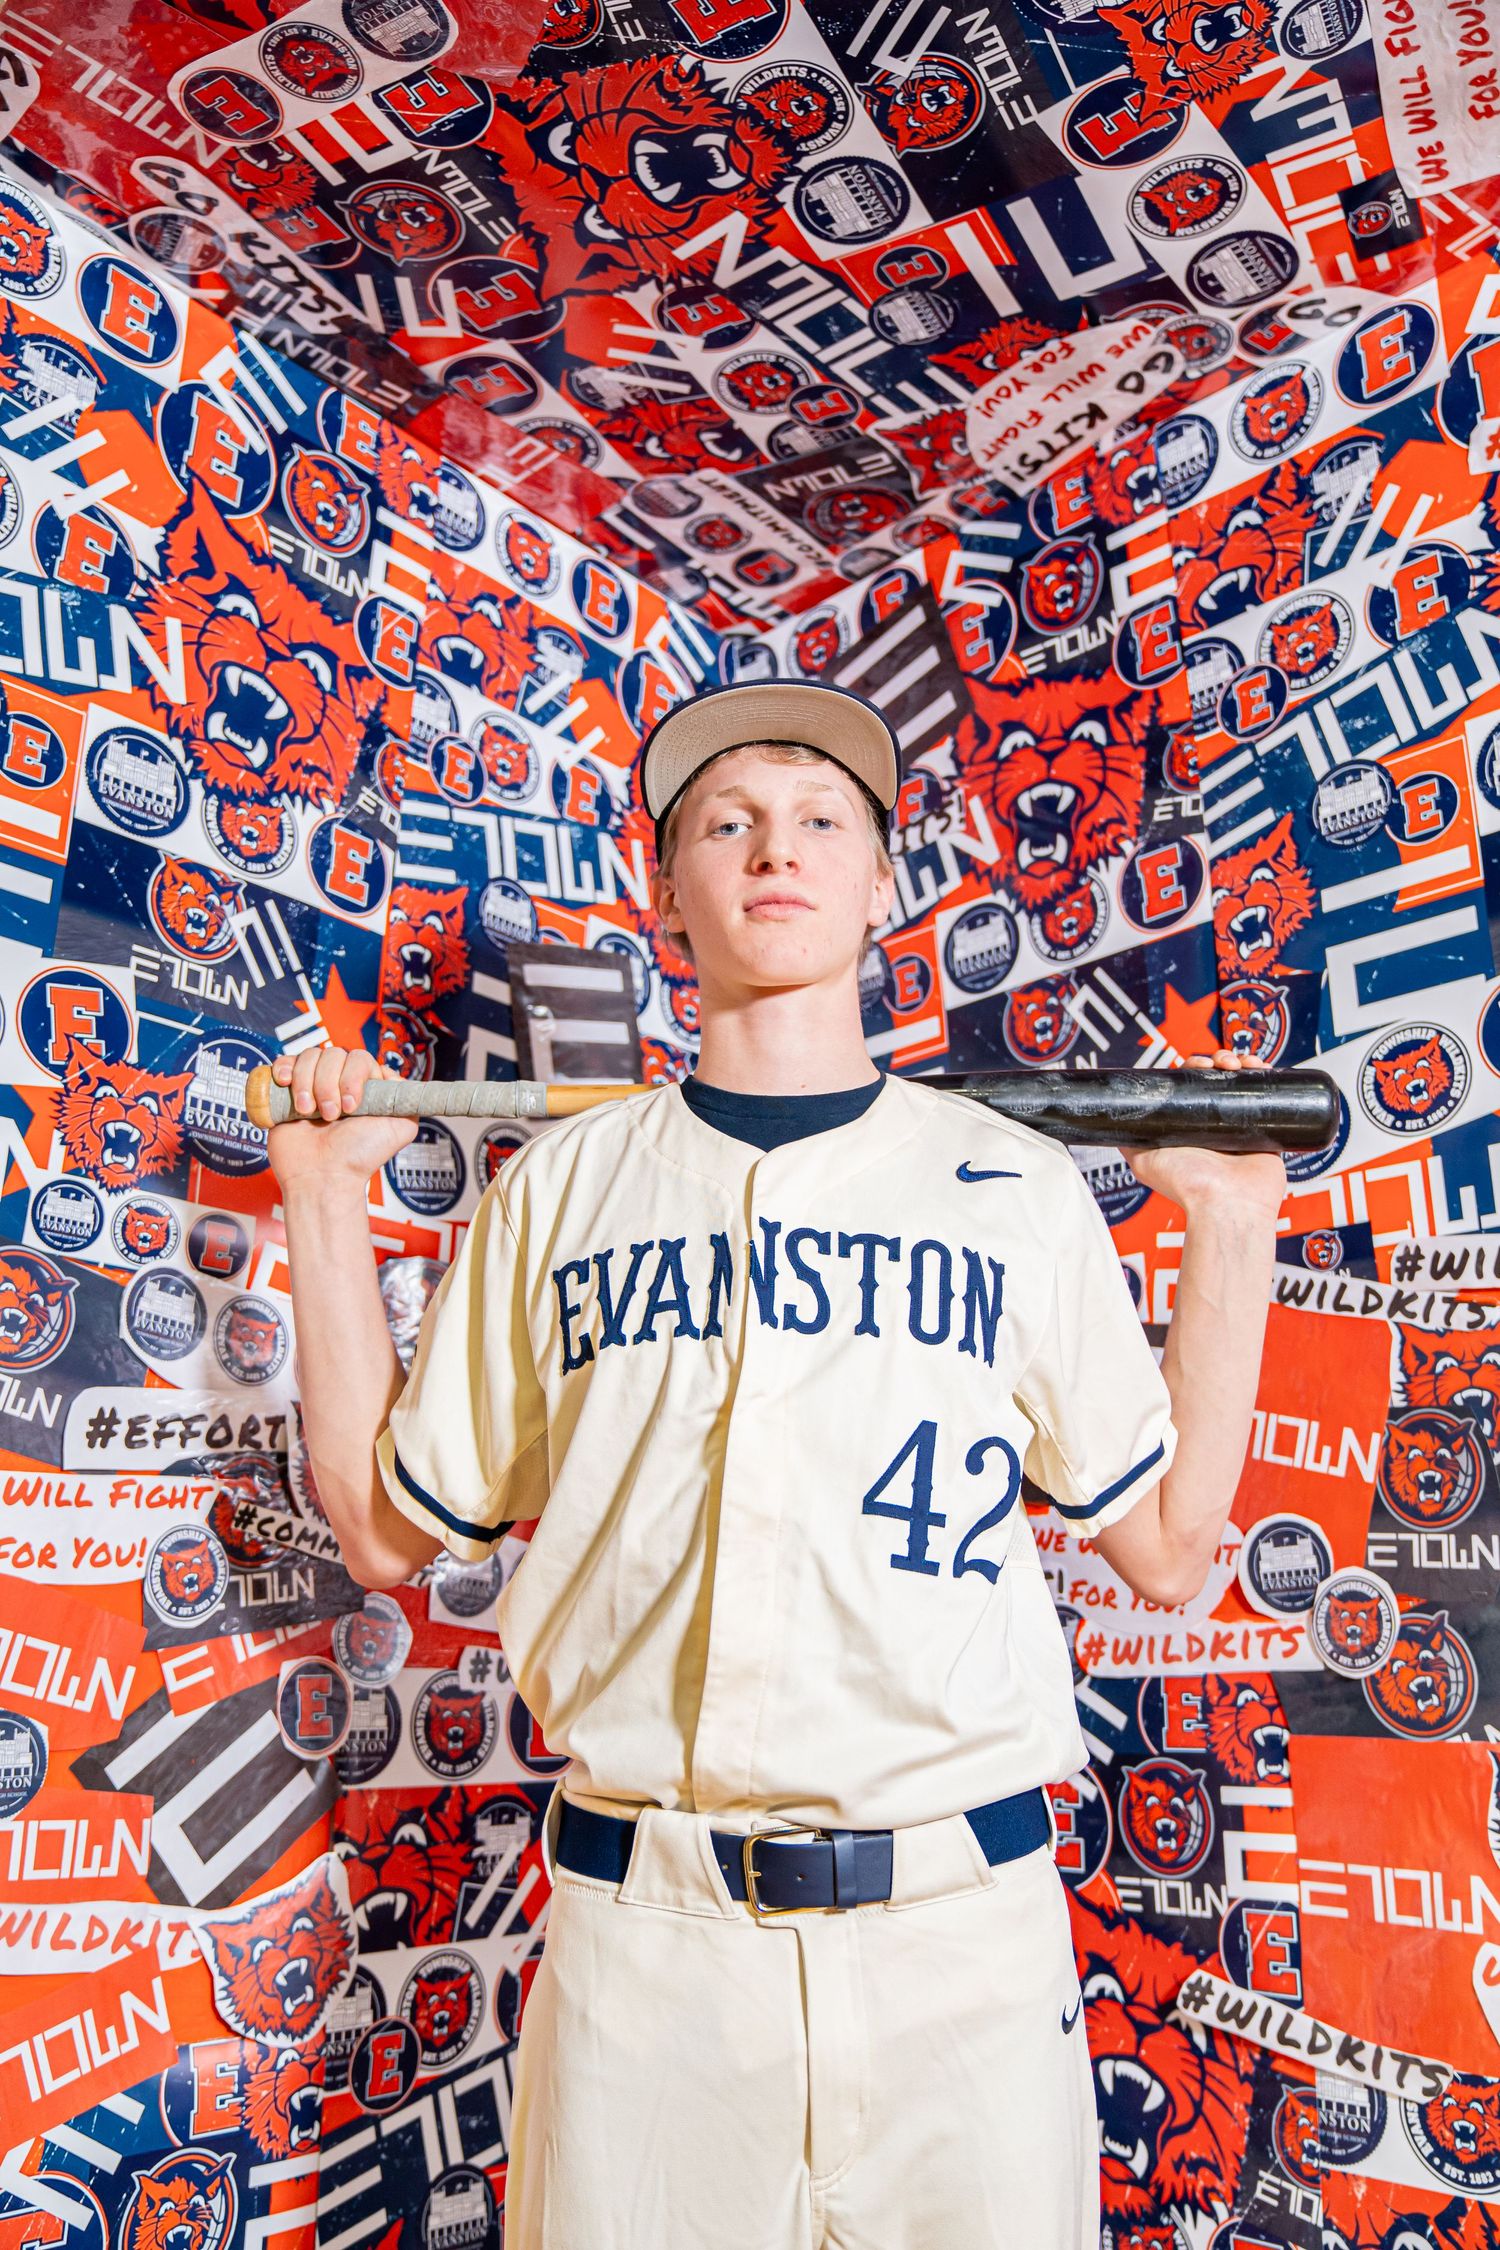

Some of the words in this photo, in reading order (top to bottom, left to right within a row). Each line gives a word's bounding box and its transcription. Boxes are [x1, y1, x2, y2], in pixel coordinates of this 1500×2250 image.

[1383, 0, 1422, 57] FIG
[1400, 65, 1439, 135] WILL
[1415, 140, 1450, 185] WE
[1023, 340, 1076, 374] FOR
[1041, 362, 1106, 403] WILL
[980, 409, 1045, 463] FIGHT
[762, 451, 899, 501] ETOWN
[267, 524, 371, 599] ETOWN
[1019, 610, 1120, 676] ETOWN
[99, 783, 175, 820] EVANSTON
[1321, 805, 1388, 836] EVANSTON
[395, 800, 651, 911] ETOWN
[129, 943, 250, 1011] ETOWN
[39, 1220, 93, 1238] EVANSTON
[552, 1215, 1006, 1377] EVANSTON
[1274, 1275, 1497, 1330] WILDKITS
[134, 1319, 195, 1343] EVANSTON
[85, 1406, 287, 1451] #EFFORT
[1251, 1409, 1381, 1483] TOWN
[2, 1475, 95, 1509] WILL
[108, 1477, 215, 1511] FIGHT
[862, 1420, 1022, 1586] 42
[0, 1536, 59, 1570] FOR
[72, 1536, 148, 1571] YOU!
[1367, 1531, 1500, 1572] ETOWN
[229, 1567, 317, 1609] TOWN
[1069, 1578, 1119, 1611] FOR
[1081, 1625, 1305, 1668] #WILDKITS
[296, 1673, 335, 1741] E
[0, 1818, 151, 1882] TOWN
[1114, 1875, 1229, 1920] ETOWN
[1243, 1908, 1304, 2001] E
[0, 1975, 171, 2103] TOWN
[1181, 1972, 1452, 2098] #WILDKITS
[367, 2029, 406, 2101] E
[1319, 2110, 1371, 2135] NSTON
